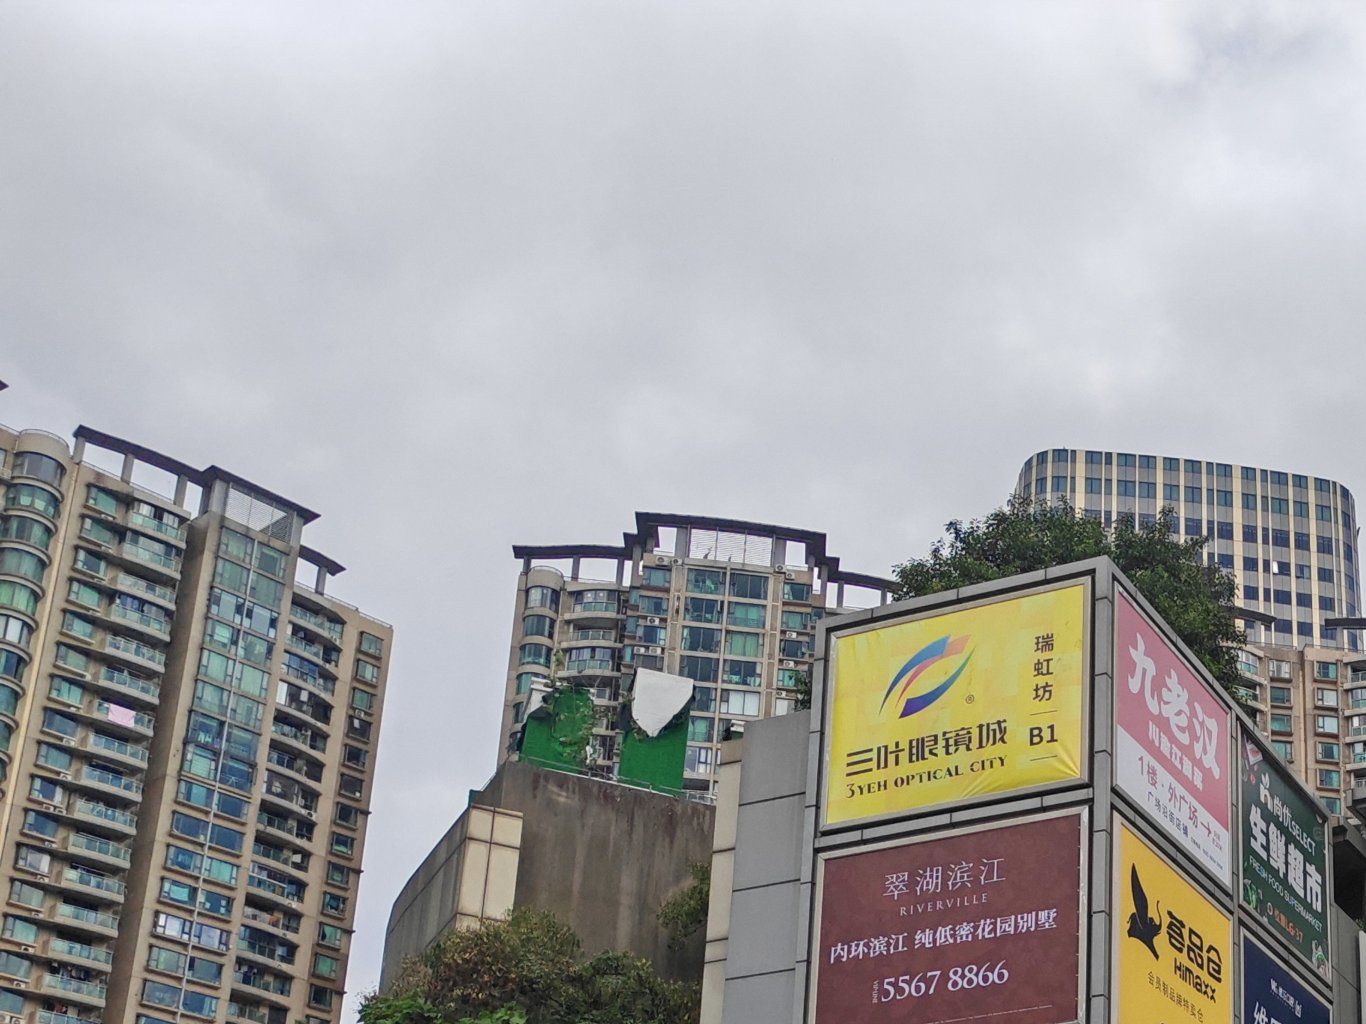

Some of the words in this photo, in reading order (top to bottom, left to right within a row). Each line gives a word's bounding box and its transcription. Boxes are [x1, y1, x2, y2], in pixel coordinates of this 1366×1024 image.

[1032, 633, 1055, 702] 瑞虹坊
[1127, 631, 1221, 780] 九老汉
[845, 718, 1008, 777] 三叶眼镜城
[1028, 723, 1059, 747] B1
[845, 780, 888, 799] 3YEH
[894, 764, 964, 788] OPTICAL
[969, 754, 1008, 773] CITY
[883, 857, 1006, 900] 翠湖滨江
[1249, 803, 1322, 913] 生鲜超市
[899, 892, 988, 916] RIVERVILLE
[1249, 855, 1268, 881] FRESH
[1268, 873, 1284, 899] FOOD
[1284, 888, 1323, 933] SUPERMARKET
[829, 932, 908, 964] 内环滨江
[913, 908, 1058, 950] 纯低密花园别墅
[881, 970, 942, 1002] 5567
[947, 959, 1009, 992] 8866
